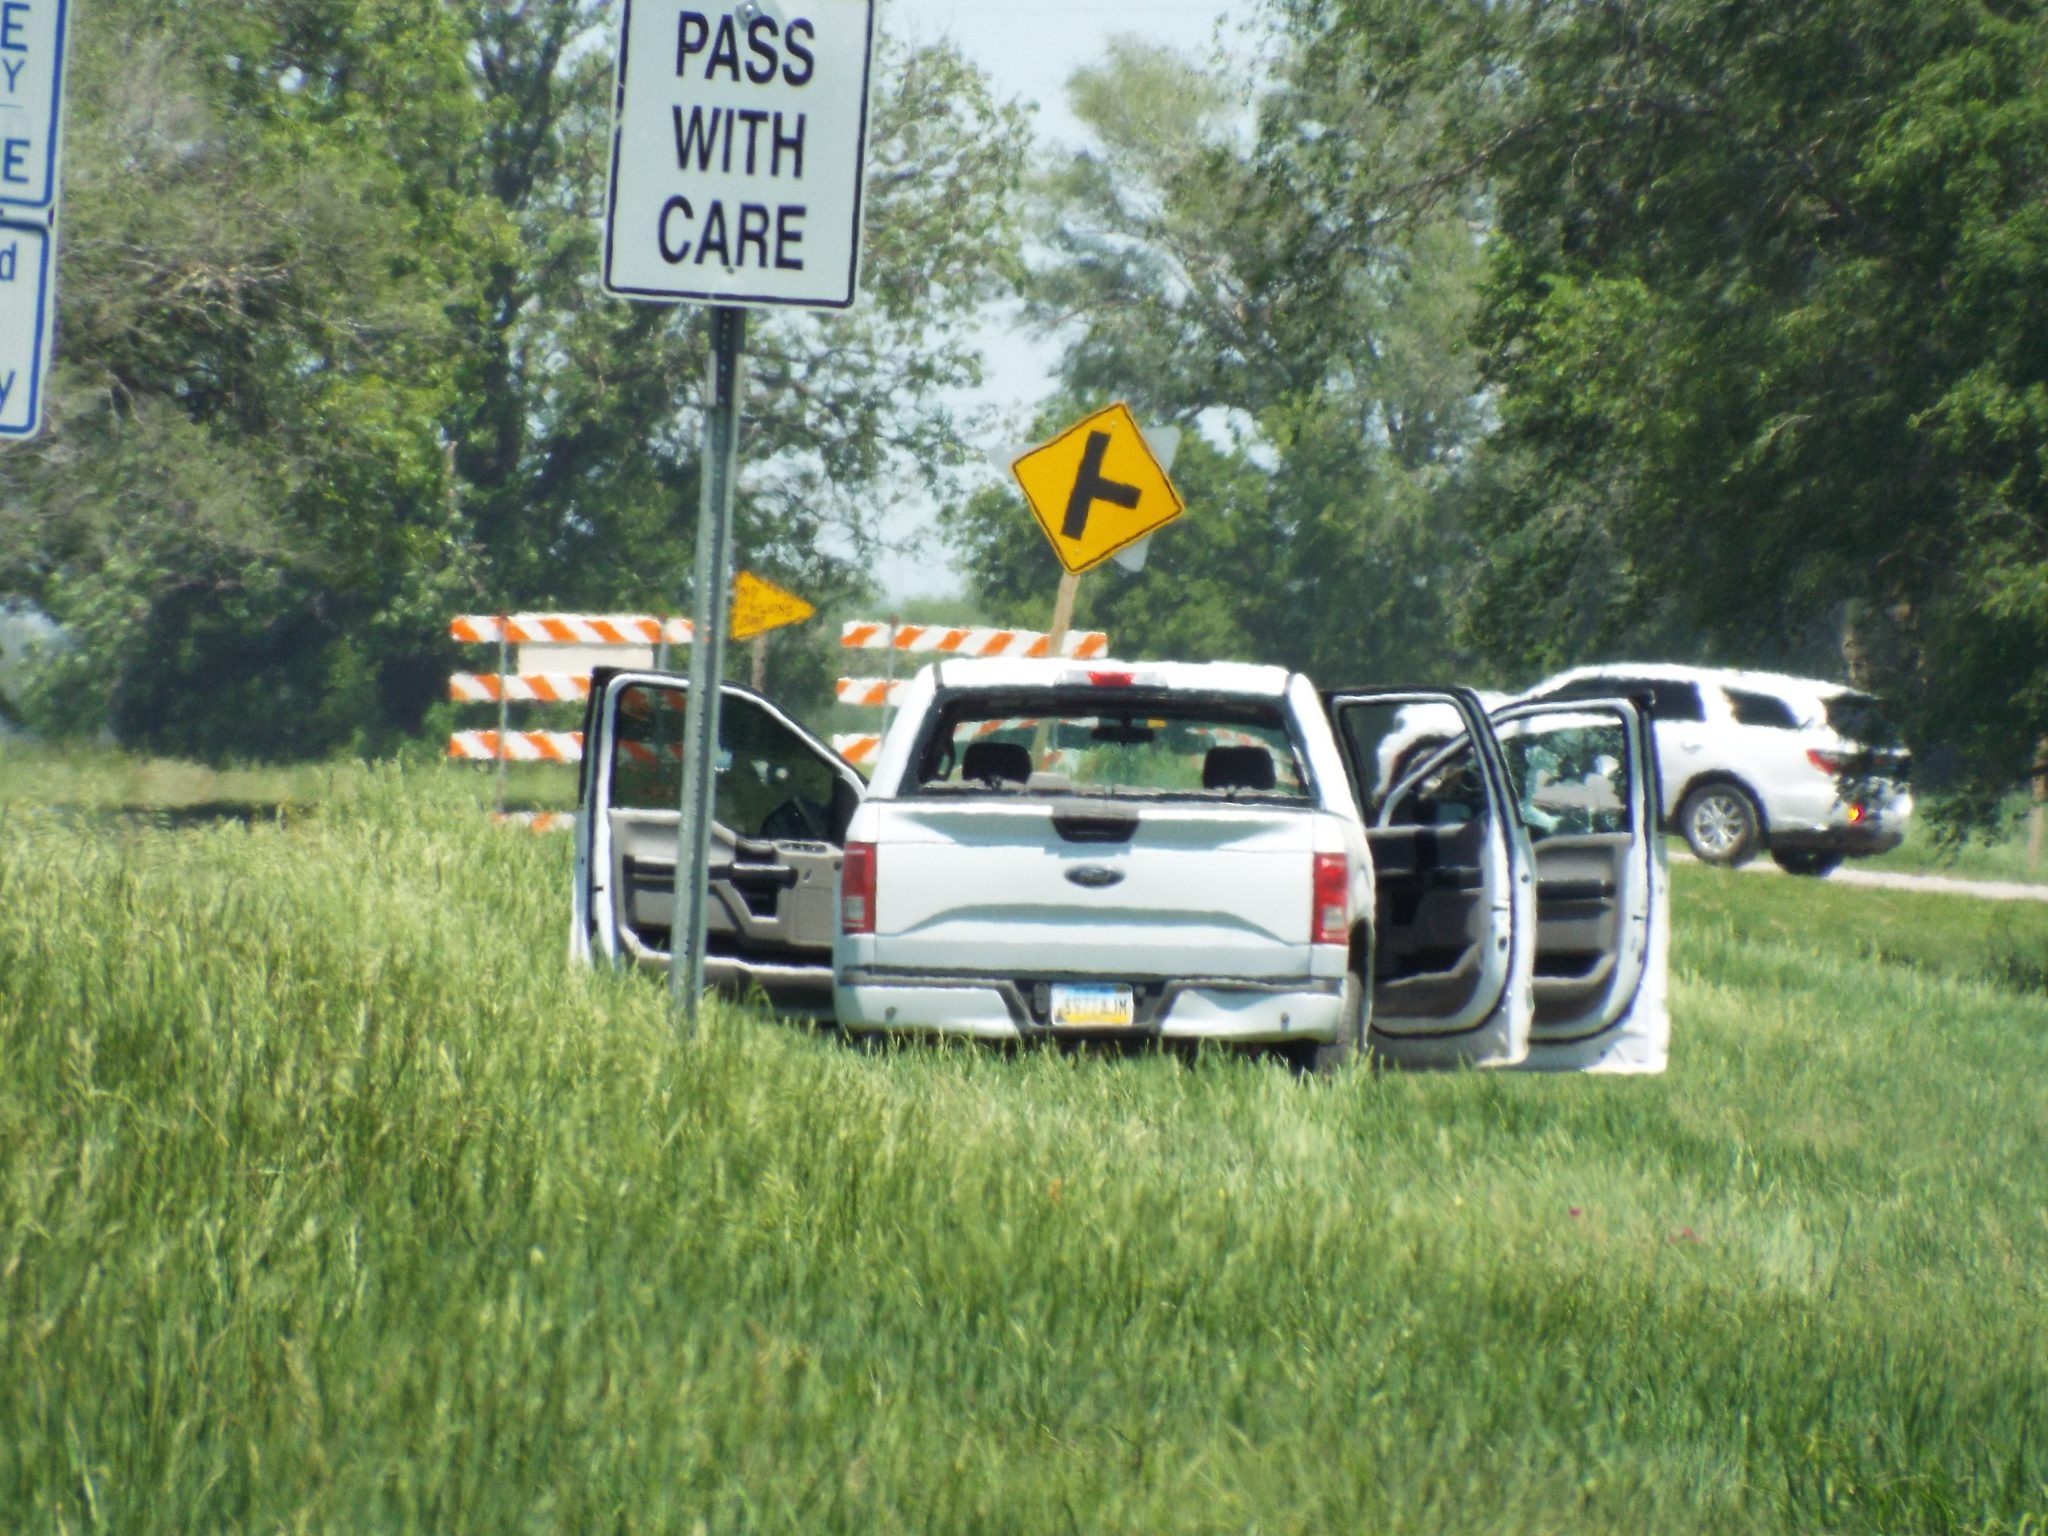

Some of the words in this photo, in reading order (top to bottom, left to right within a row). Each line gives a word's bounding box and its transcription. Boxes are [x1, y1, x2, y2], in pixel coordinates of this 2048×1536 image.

[676, 10, 816, 86] PASS
[3, 138, 31, 183] E
[671, 104, 806, 179] WITH
[657, 194, 806, 271] CARE
